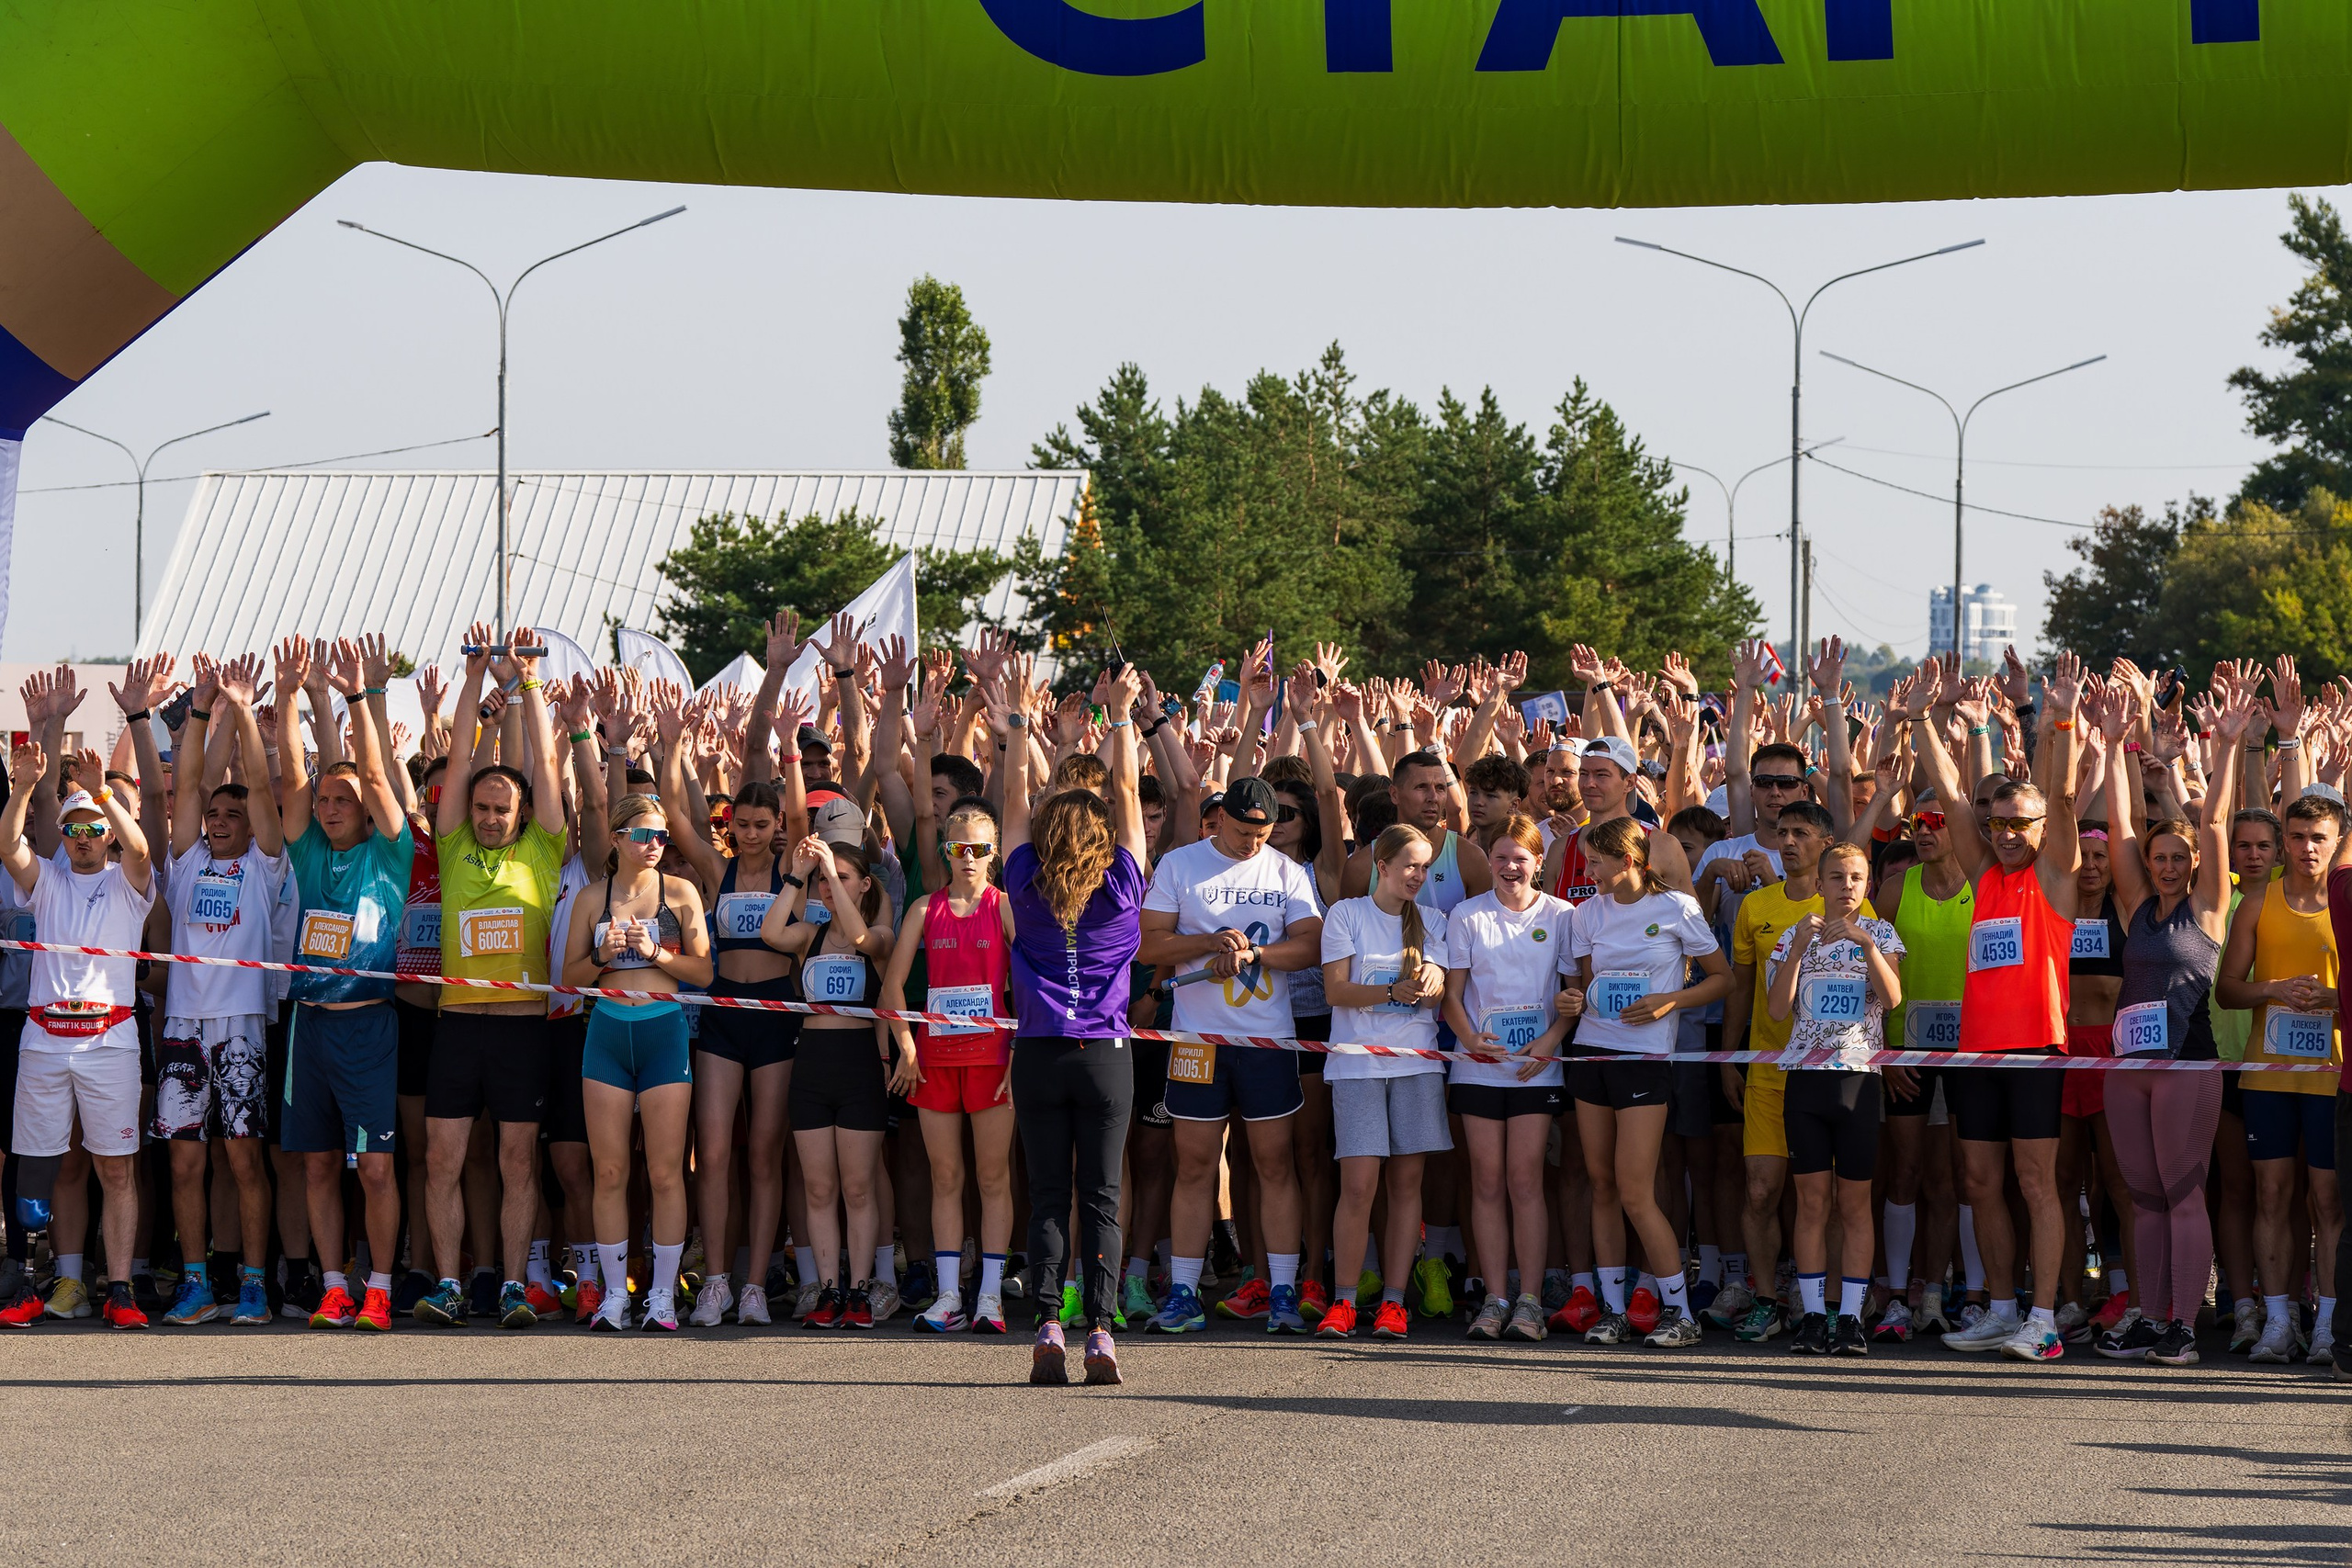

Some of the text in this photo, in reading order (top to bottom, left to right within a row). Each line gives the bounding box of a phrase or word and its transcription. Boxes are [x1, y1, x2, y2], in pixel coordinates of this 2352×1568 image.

[201, 888, 226, 897] РОДИОН
[1570, 886, 1597, 897] PRO
[1220, 890, 1287, 908] ТЕСЕЙ
[195, 898, 232, 919] 4065
[744, 903, 765, 912] СОФЬЯ
[313, 921, 349, 934] АЛЕКСАНДР
[479, 919, 518, 930] ВЛАДИСЛАВ
[478, 930, 519, 951] 6002.1
[1982, 929, 2014, 942] ГЕННАДИЙ
[309, 931, 346, 953] 6003.1
[1982, 941, 2017, 963] 4539
[829, 965, 852, 975] СОФИЯ
[827, 976, 855, 995] 697
[1608, 983, 1641, 991] ВИКТОРИЯ
[1827, 984, 1854, 993] МАТВЕЙ
[945, 997, 989, 1008] АЛЕКСАНДРА
[1820, 995, 1860, 1014] 2297
[1501, 1016, 1538, 1026] ЕКАТЕРИНА
[1936, 1012, 1956, 1021] ИГОРЬ
[2129, 1013, 2158, 1025] СВЕТЛАНА
[2290, 1020, 2322, 1030] АЛЕКСЕЙ
[1507, 1027, 1535, 1046] 408
[2129, 1024, 2162, 1046] 1293
[2288, 1031, 2325, 1052] 1285
[1178, 1046, 1204, 1057] КИРИЛЛ
[1172, 1057, 1209, 1079] 6005.1
